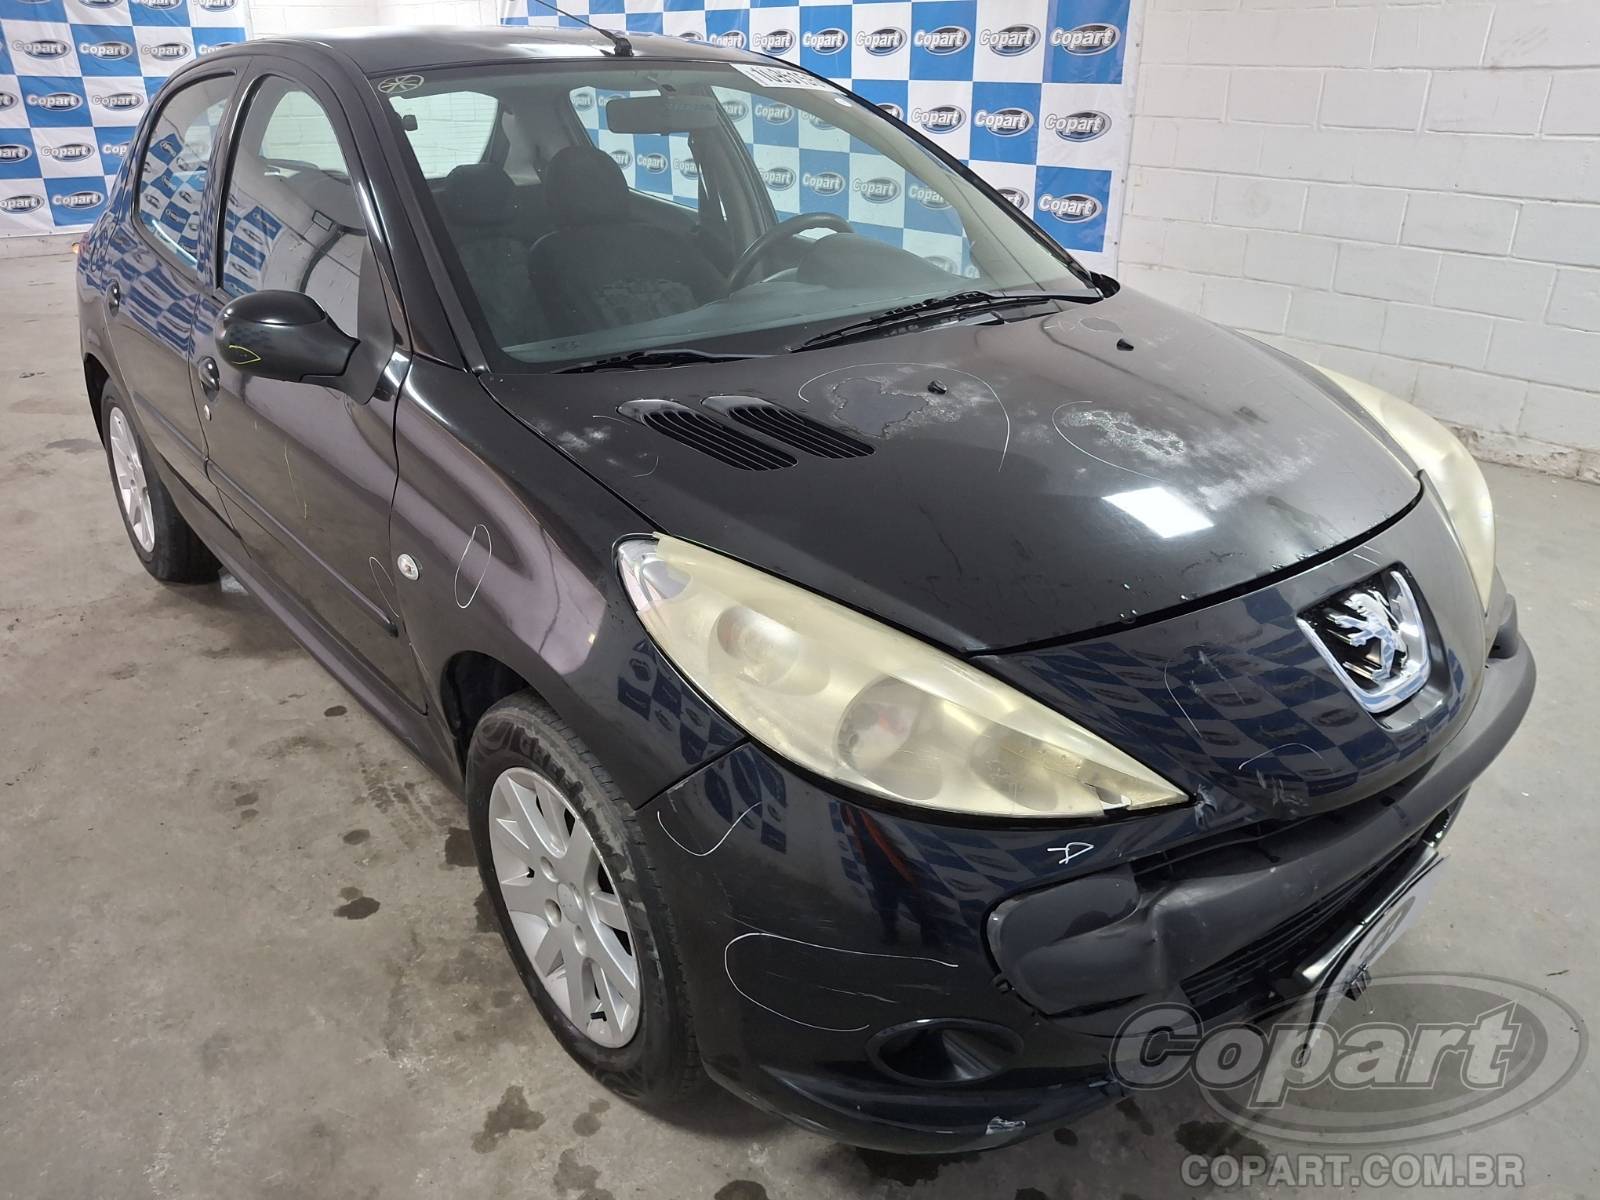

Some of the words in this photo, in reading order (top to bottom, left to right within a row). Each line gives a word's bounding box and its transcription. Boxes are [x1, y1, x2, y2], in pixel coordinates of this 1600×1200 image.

[752, 33, 791, 48] Copart
[802, 32, 842, 49] Copart
[856, 31, 900, 50] Copart
[914, 30, 964, 50] Copart
[980, 28, 1034, 50] Copart
[1051, 28, 1114, 50] Copart
[13, 40, 65, 54] Copart
[80, 43, 126, 56] Copart
[142, 45, 185, 56] Copart
[27, 95, 77, 107] Copart
[92, 95, 138, 107] Copart
[755, 104, 790, 120] Copart
[912, 108, 959, 127] Copart
[975, 110, 1029, 131] Copart
[1044, 114, 1101, 135] Copart
[41, 146, 88, 159] Copart
[103, 144, 127, 155] Cop
[637, 154, 664, 168] Copart
[673, 159, 697, 173] Copa
[802, 173, 841, 189] Copart
[853, 178, 894, 196] Copart
[0, 197, 37, 209] opart
[52, 194, 98, 205] Copart
[1039, 194, 1093, 216] Copart
